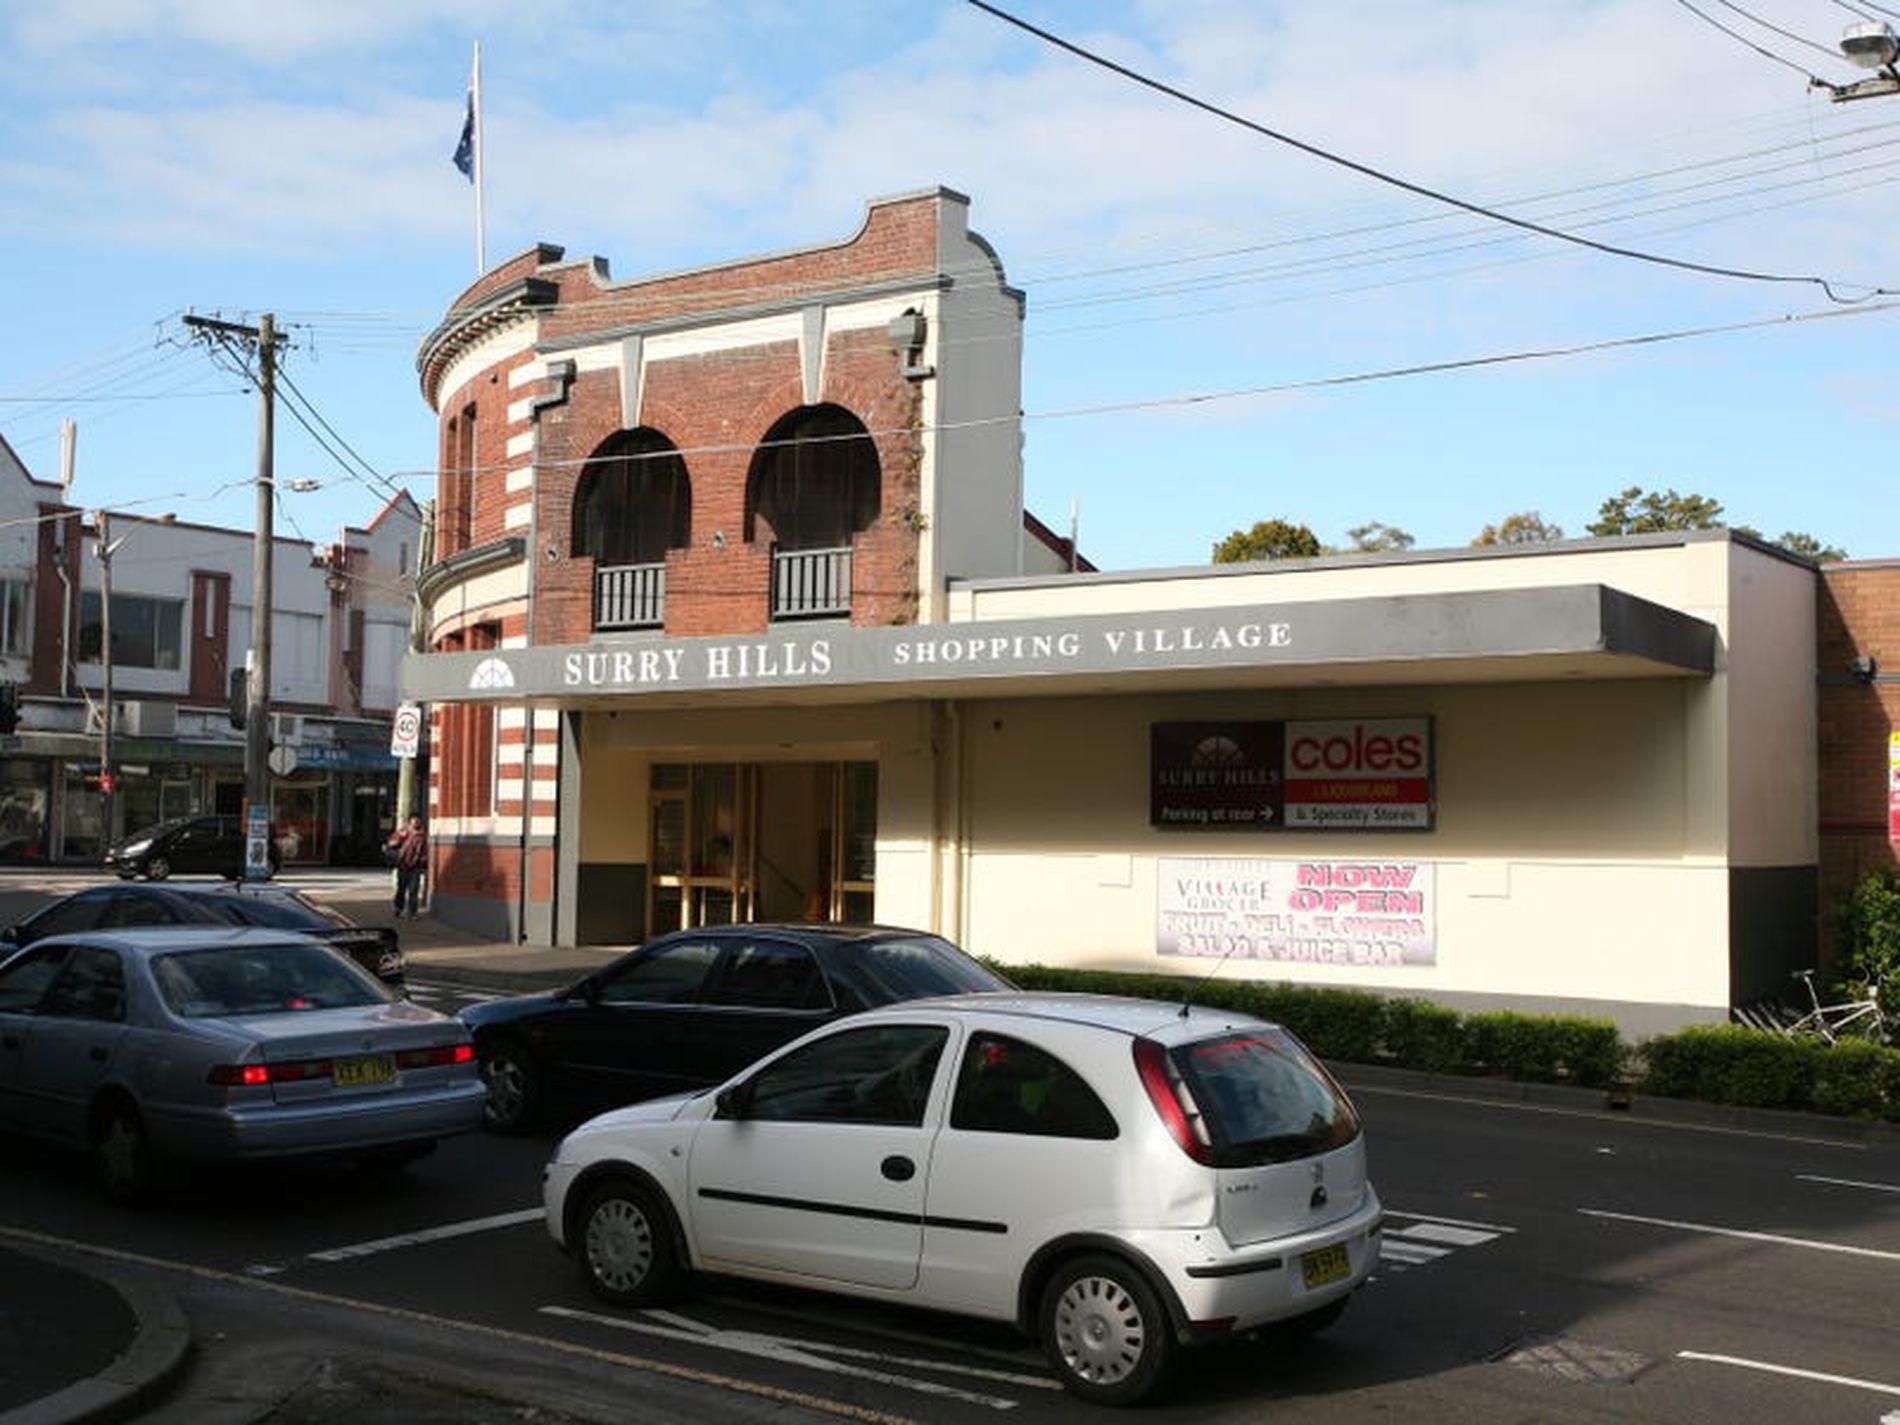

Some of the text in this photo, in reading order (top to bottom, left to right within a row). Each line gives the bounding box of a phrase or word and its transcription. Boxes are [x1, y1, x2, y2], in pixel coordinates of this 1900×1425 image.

[564, 623, 1293, 685] SURRY HILLS SHOPPING VILLAGE
[1291, 725, 1423, 771] coles
[1312, 807, 1370, 825] Specialty
[1374, 807, 1416, 821] Stores
[1297, 864, 1416, 888] NOW
[1177, 879, 1271, 901] VILLAGE
[1288, 888, 1423, 913] OPEN
